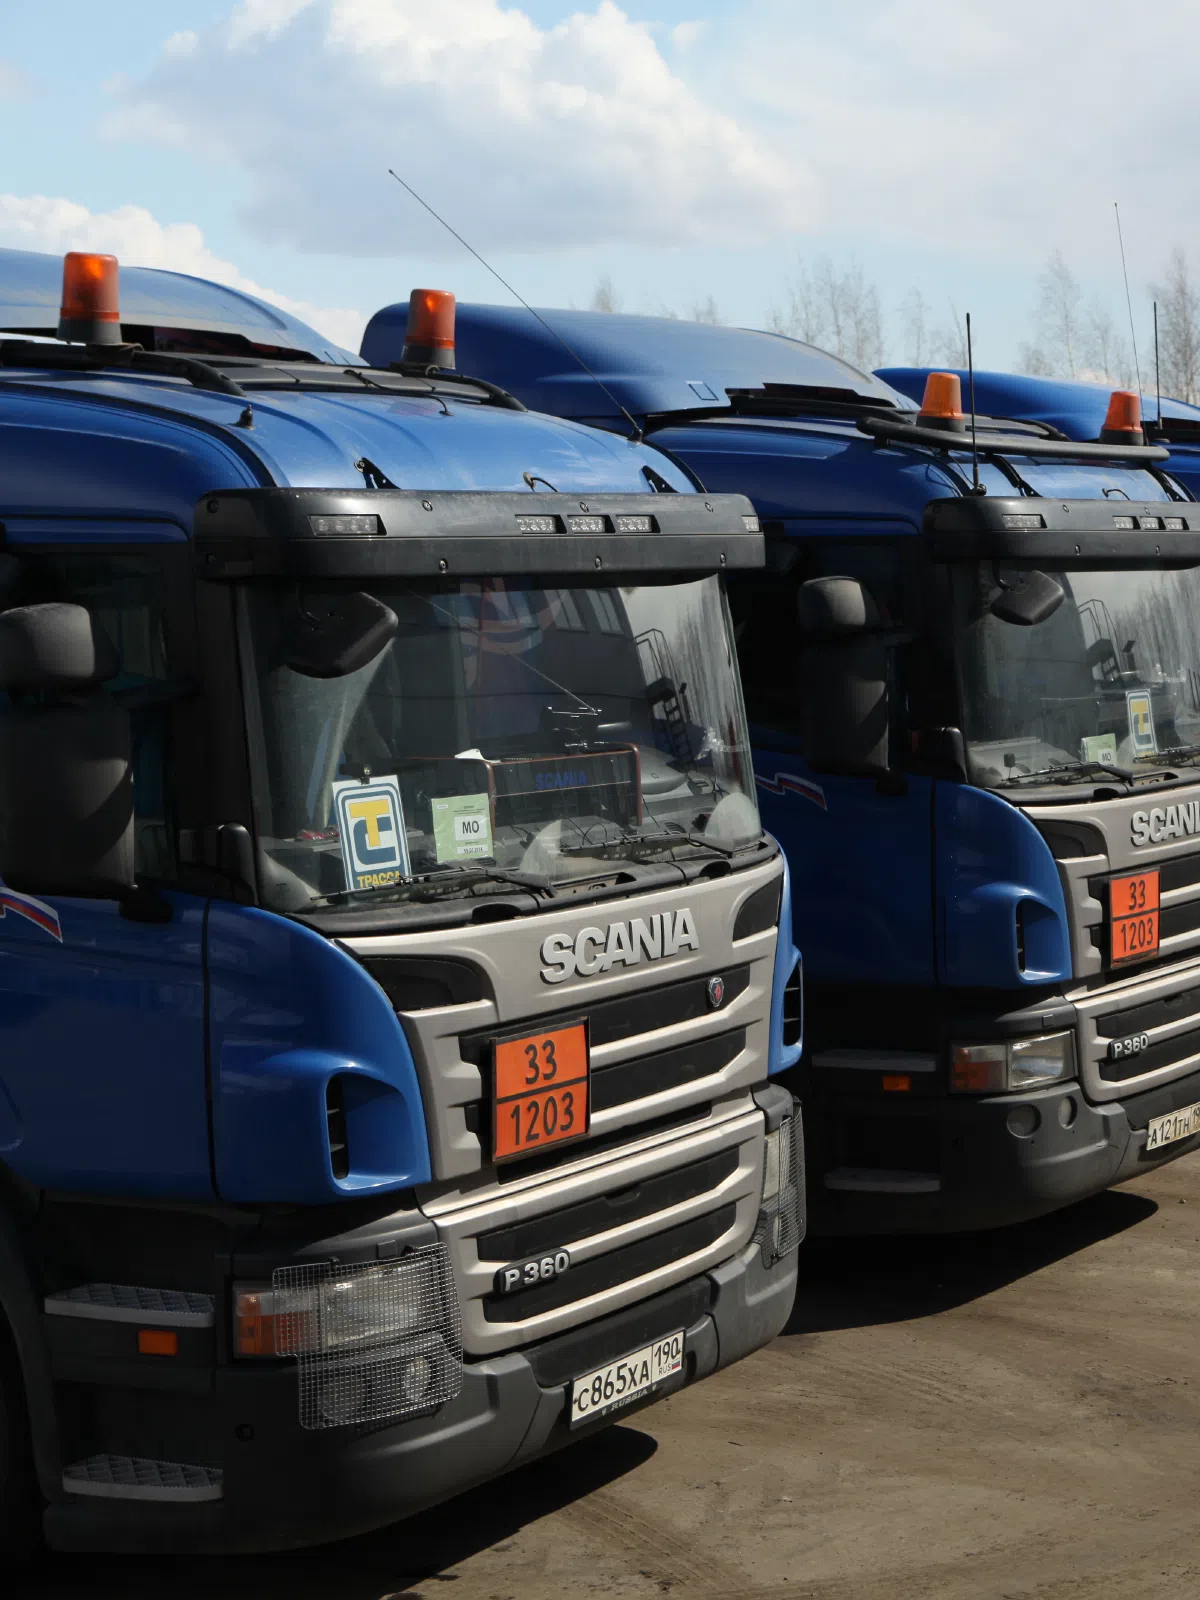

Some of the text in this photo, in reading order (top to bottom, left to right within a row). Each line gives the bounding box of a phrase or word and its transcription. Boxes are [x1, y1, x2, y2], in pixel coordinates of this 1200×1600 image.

[535, 770, 588, 790] SCANIA
[1128, 879, 1146, 910] 33
[540, 907, 700, 984] SCANIA
[1121, 917, 1154, 953] 1203
[524, 1039, 558, 1084] 33
[1114, 1034, 1149, 1058] P 360
[510, 1091, 574, 1146] 1203
[504, 1252, 570, 1292] P 360
[654, 1336, 681, 1368] 190
[658, 1363, 672, 1376] RUS
[610, 1389, 648, 1412] RUSSIA
